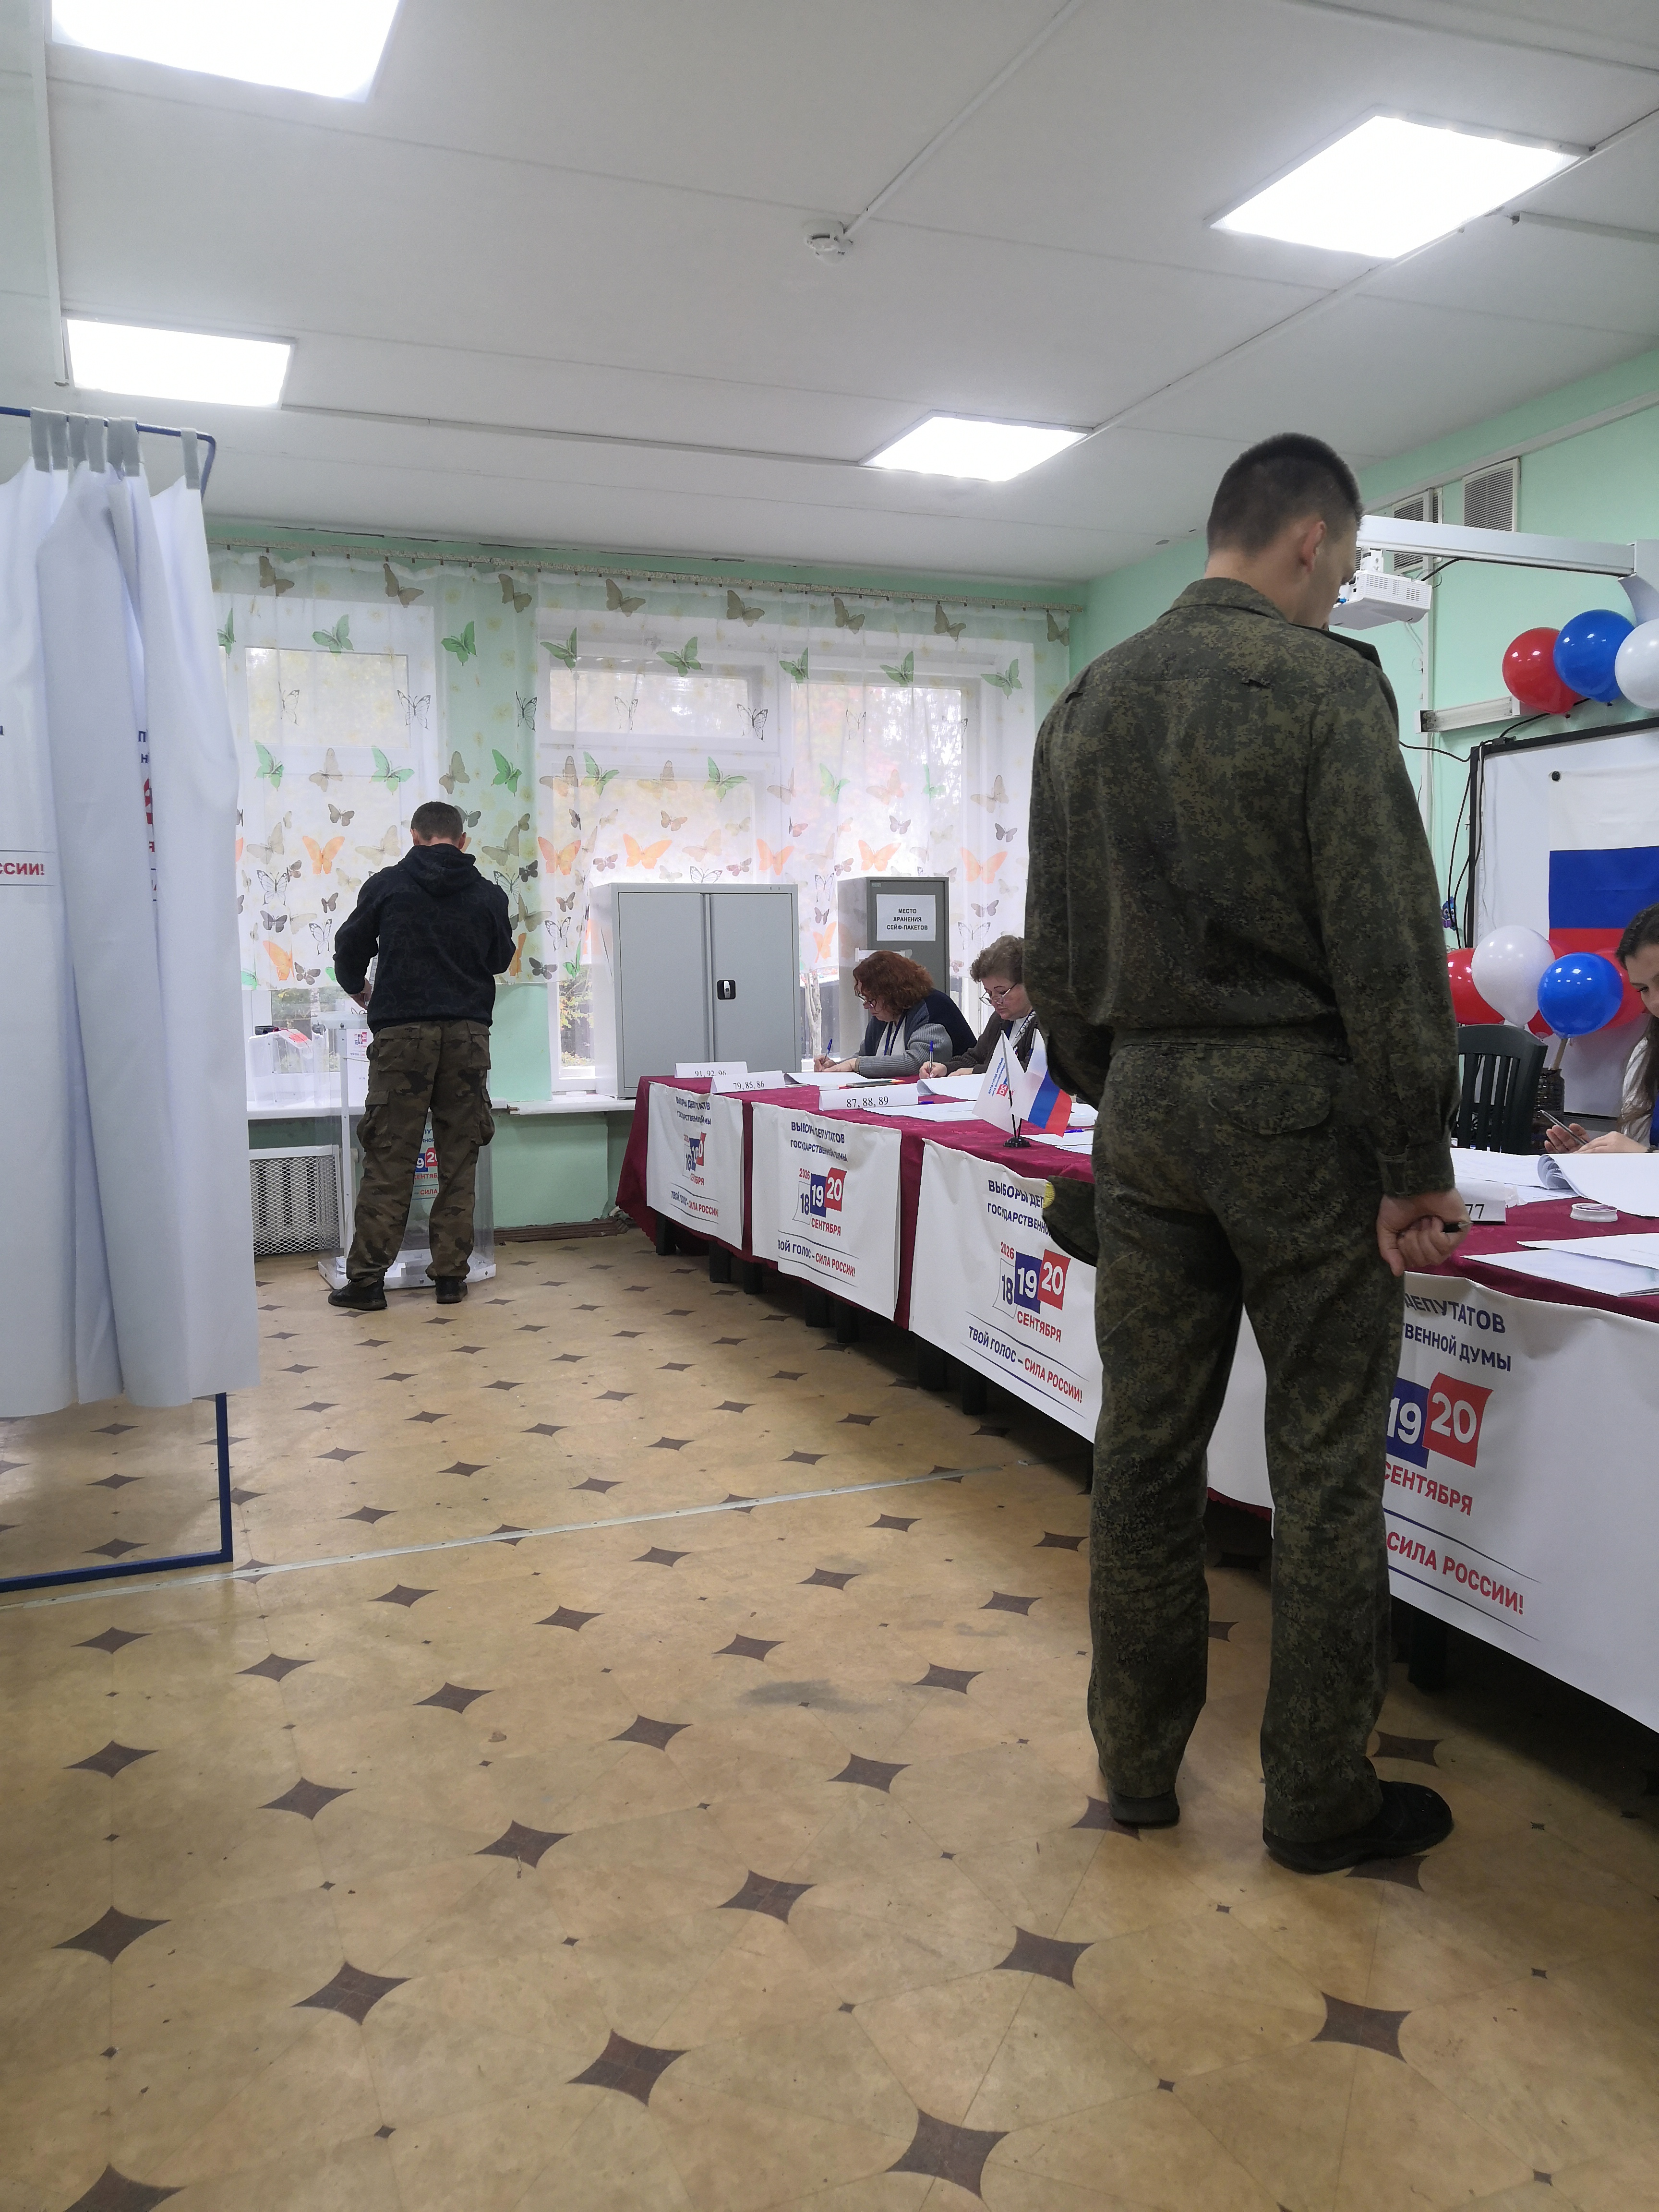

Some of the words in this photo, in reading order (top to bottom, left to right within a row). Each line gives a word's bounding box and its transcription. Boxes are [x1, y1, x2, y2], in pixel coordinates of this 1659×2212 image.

[0, 863, 45, 876] СИИ!
[733, 1082, 744, 1090] 79,
[745, 1081, 755, 1089] 85,
[757, 1080, 765, 1088] 86
[847, 1098, 860, 1107] 87,
[863, 1097, 876, 1107] 88,
[878, 1096, 889, 1105] 89
[685, 1153, 692, 1171] 18
[799, 1168, 810, 1180] 2026
[800, 1192, 809, 1215] 18
[812, 1184, 824, 1207] 19
[827, 1177, 842, 1201] 20
[988, 1179, 1028, 1203] ВЫБОРЫ
[811, 1218, 841, 1236] СЕНТЯБРЯ
[778, 1239, 790, 1252] ВОЙ
[792, 1244, 811, 1259] ГОЛОС
[816, 1252, 830, 1267] СИЛА
[832, 1258, 855, 1278] РОССИИ!
[1000, 1241, 1014, 1260] 2026
[1001, 1274, 1013, 1305] 18
[1018, 1267, 1037, 1298] 19
[1041, 1262, 1063, 1295] 20
[1017, 1310, 1061, 1343] СЕНТЯБРЯ
[1405, 1293, 1506, 1334] ДЕПУТАТОВ
[969, 1325, 989, 1347] ТВОЙ
[990, 1338, 1016, 1362] ГОЛОС
[1024, 1358, 1046, 1381] СИЛА
[1047, 1370, 1082, 1403] РОССИИ!
[1459, 1343, 1511, 1372] ДУМЫ
[1387, 1397, 1422, 1444] 19
[1431, 1392, 1477, 1443] 20
[1384, 1461, 1473, 1516] СЕНТЯБРЯ
[1387, 1531, 1437, 1571] СИЛА
[1442, 1555, 1523, 1615] РОССИИ!
